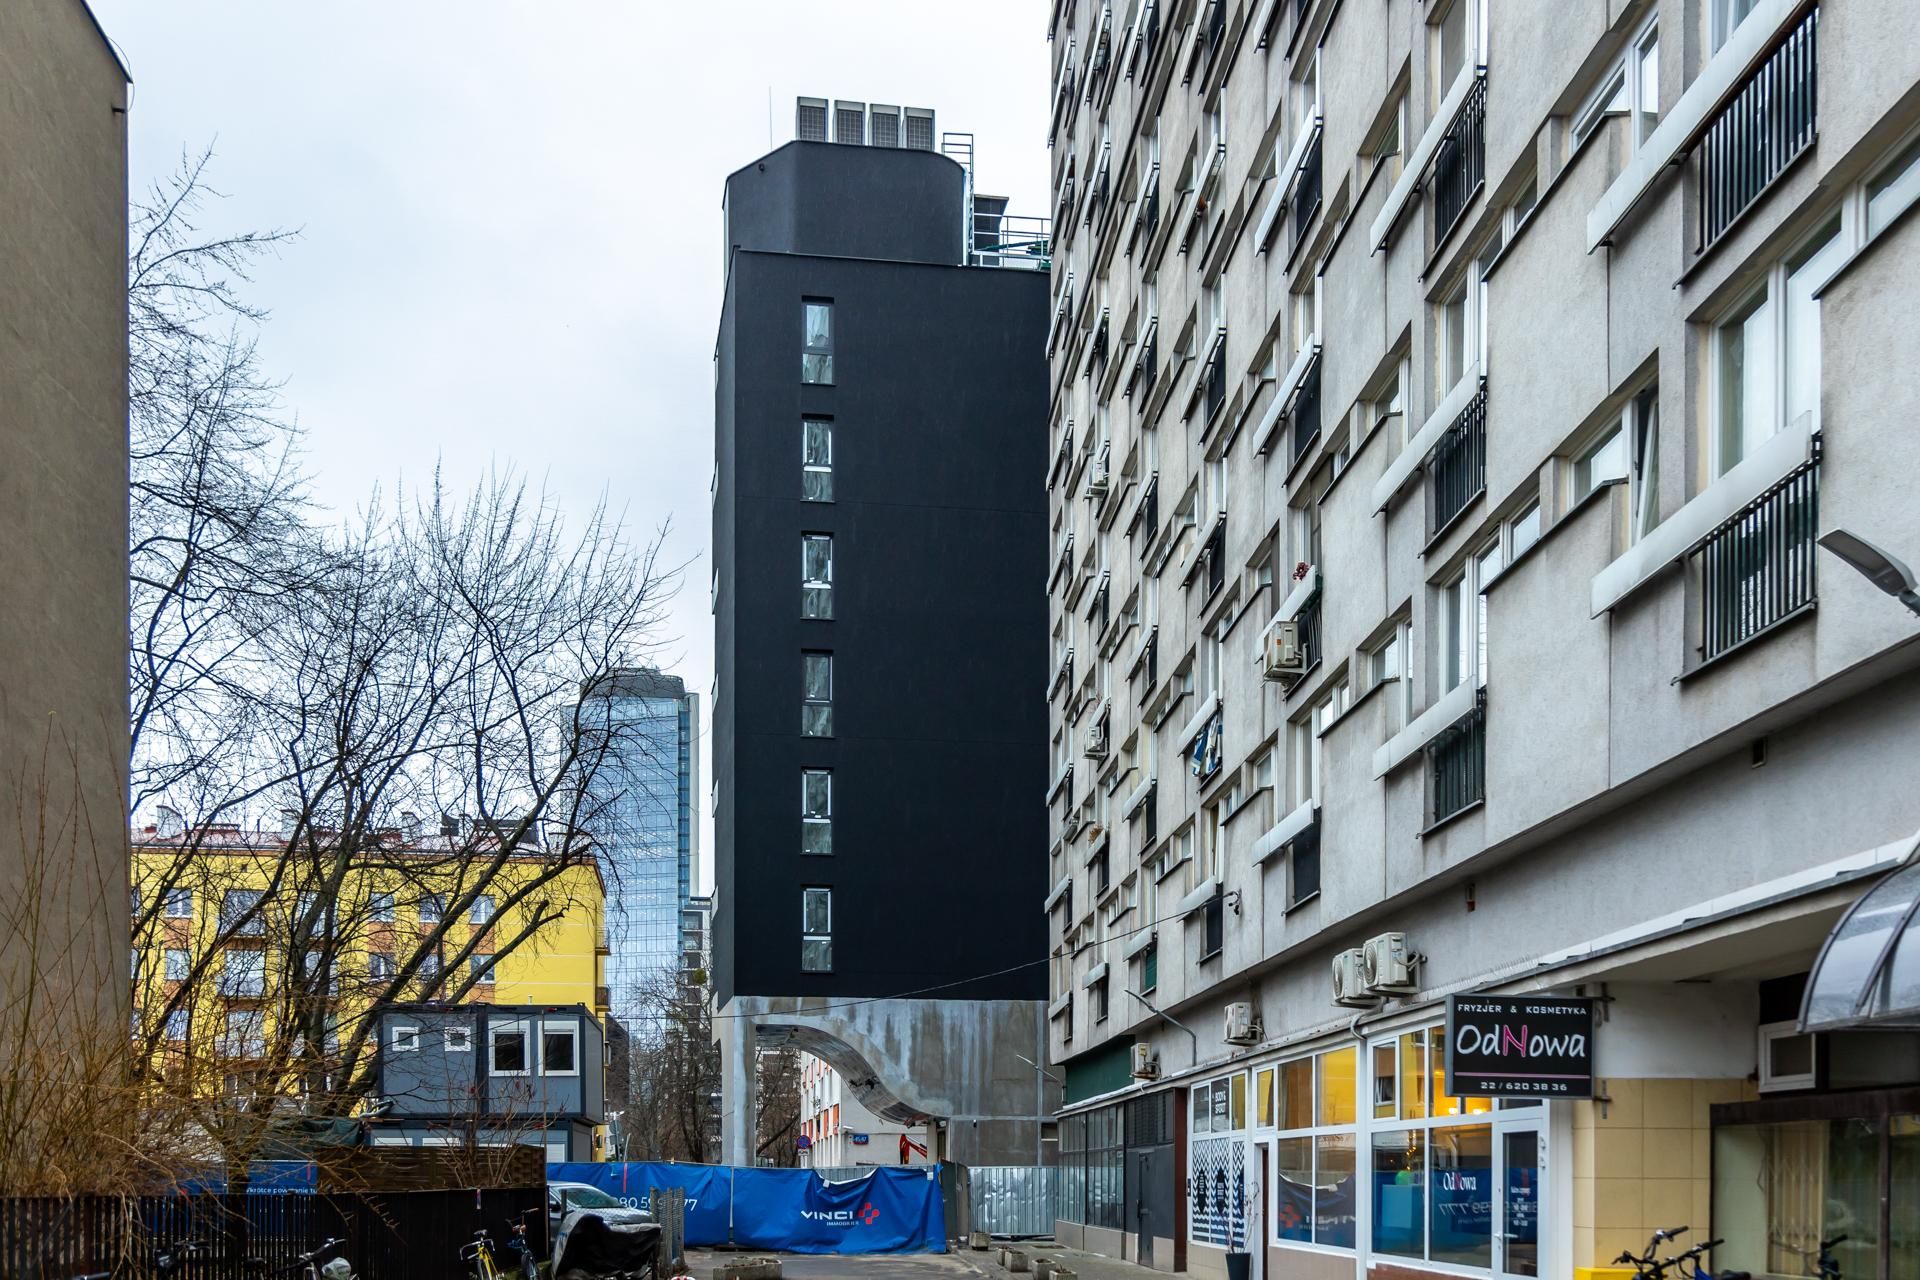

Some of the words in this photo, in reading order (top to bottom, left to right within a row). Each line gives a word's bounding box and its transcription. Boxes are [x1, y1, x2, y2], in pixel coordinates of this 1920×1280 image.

[1458, 1004, 1502, 1013] FRYZJER
[1510, 1005, 1517, 1013] &
[1526, 1006, 1587, 1015] KOSMETYKA
[1457, 1024, 1586, 1058] OdNowa
[1533, 1083, 1549, 1091] 38
[1552, 1083, 1568, 1091] 36
[1443, 1172, 1477, 1191] OdNowa
[800, 1210, 854, 1221] VINCI
